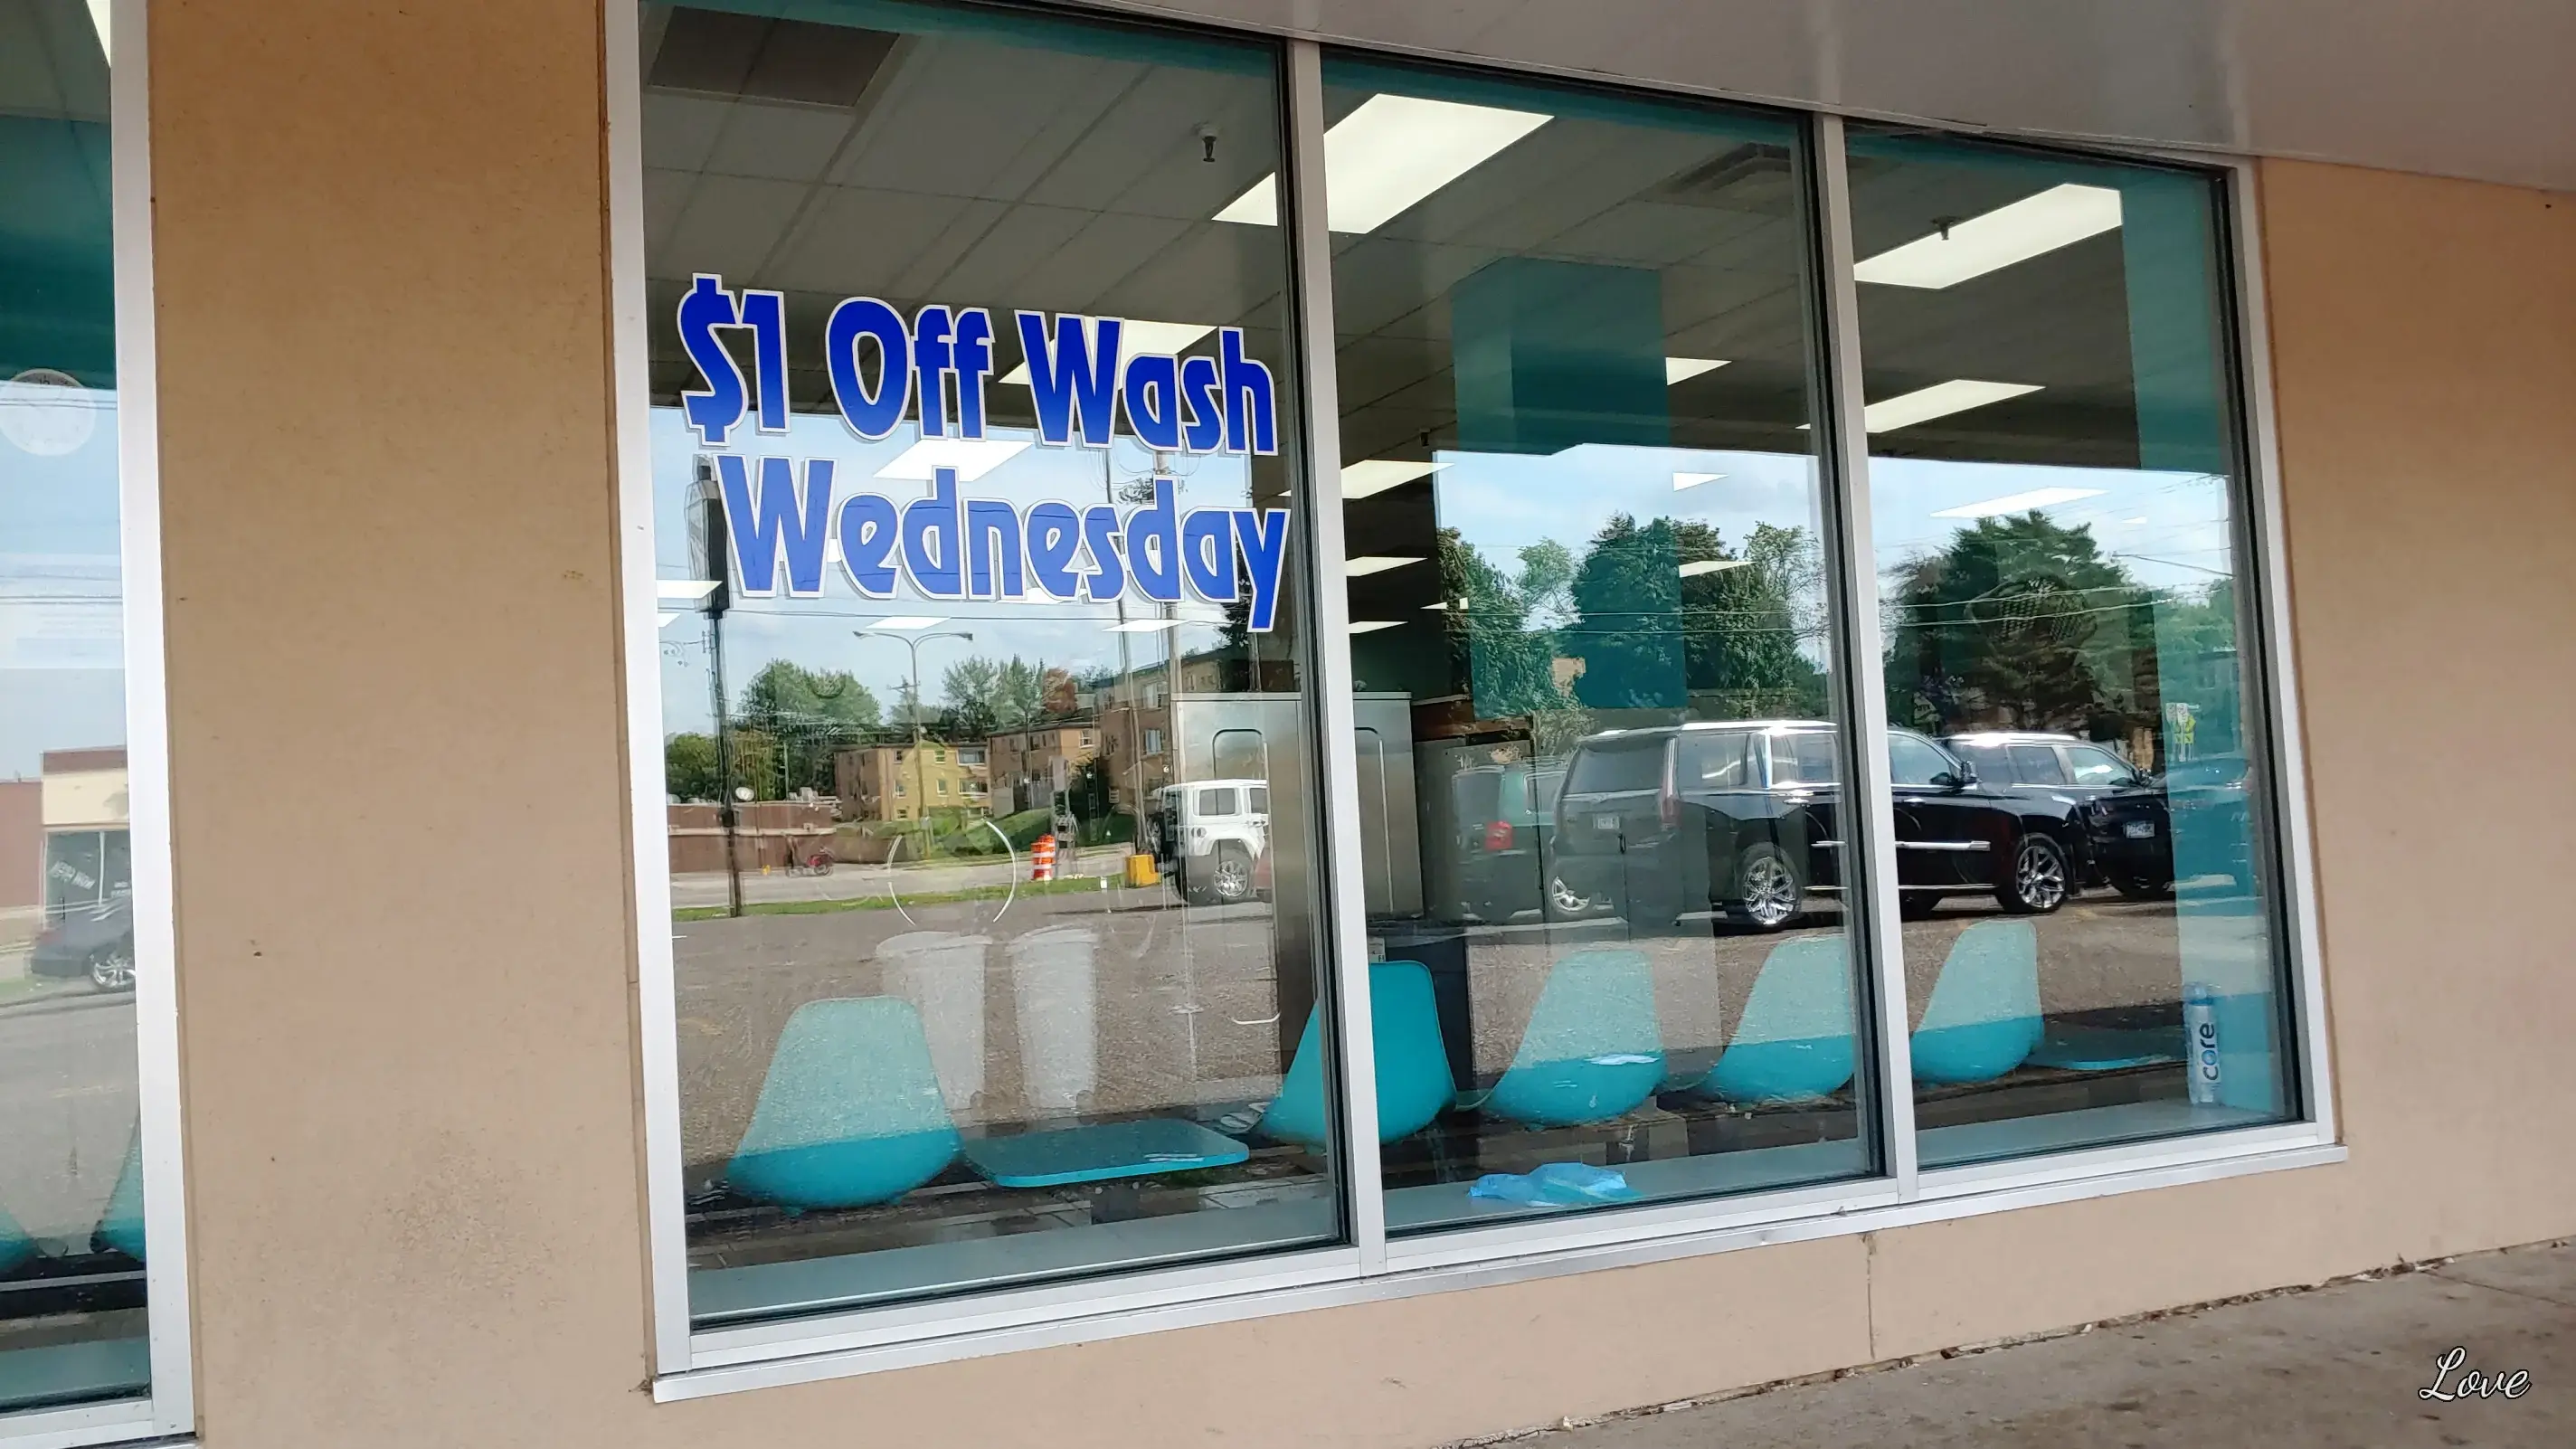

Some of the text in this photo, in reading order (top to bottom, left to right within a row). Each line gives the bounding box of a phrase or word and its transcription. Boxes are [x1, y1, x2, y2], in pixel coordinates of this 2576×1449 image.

[677, 273, 1278, 456] $1 Off Wash
[714, 454, 1291, 633] Wednesday
[2200, 1023, 2219, 1081] core
